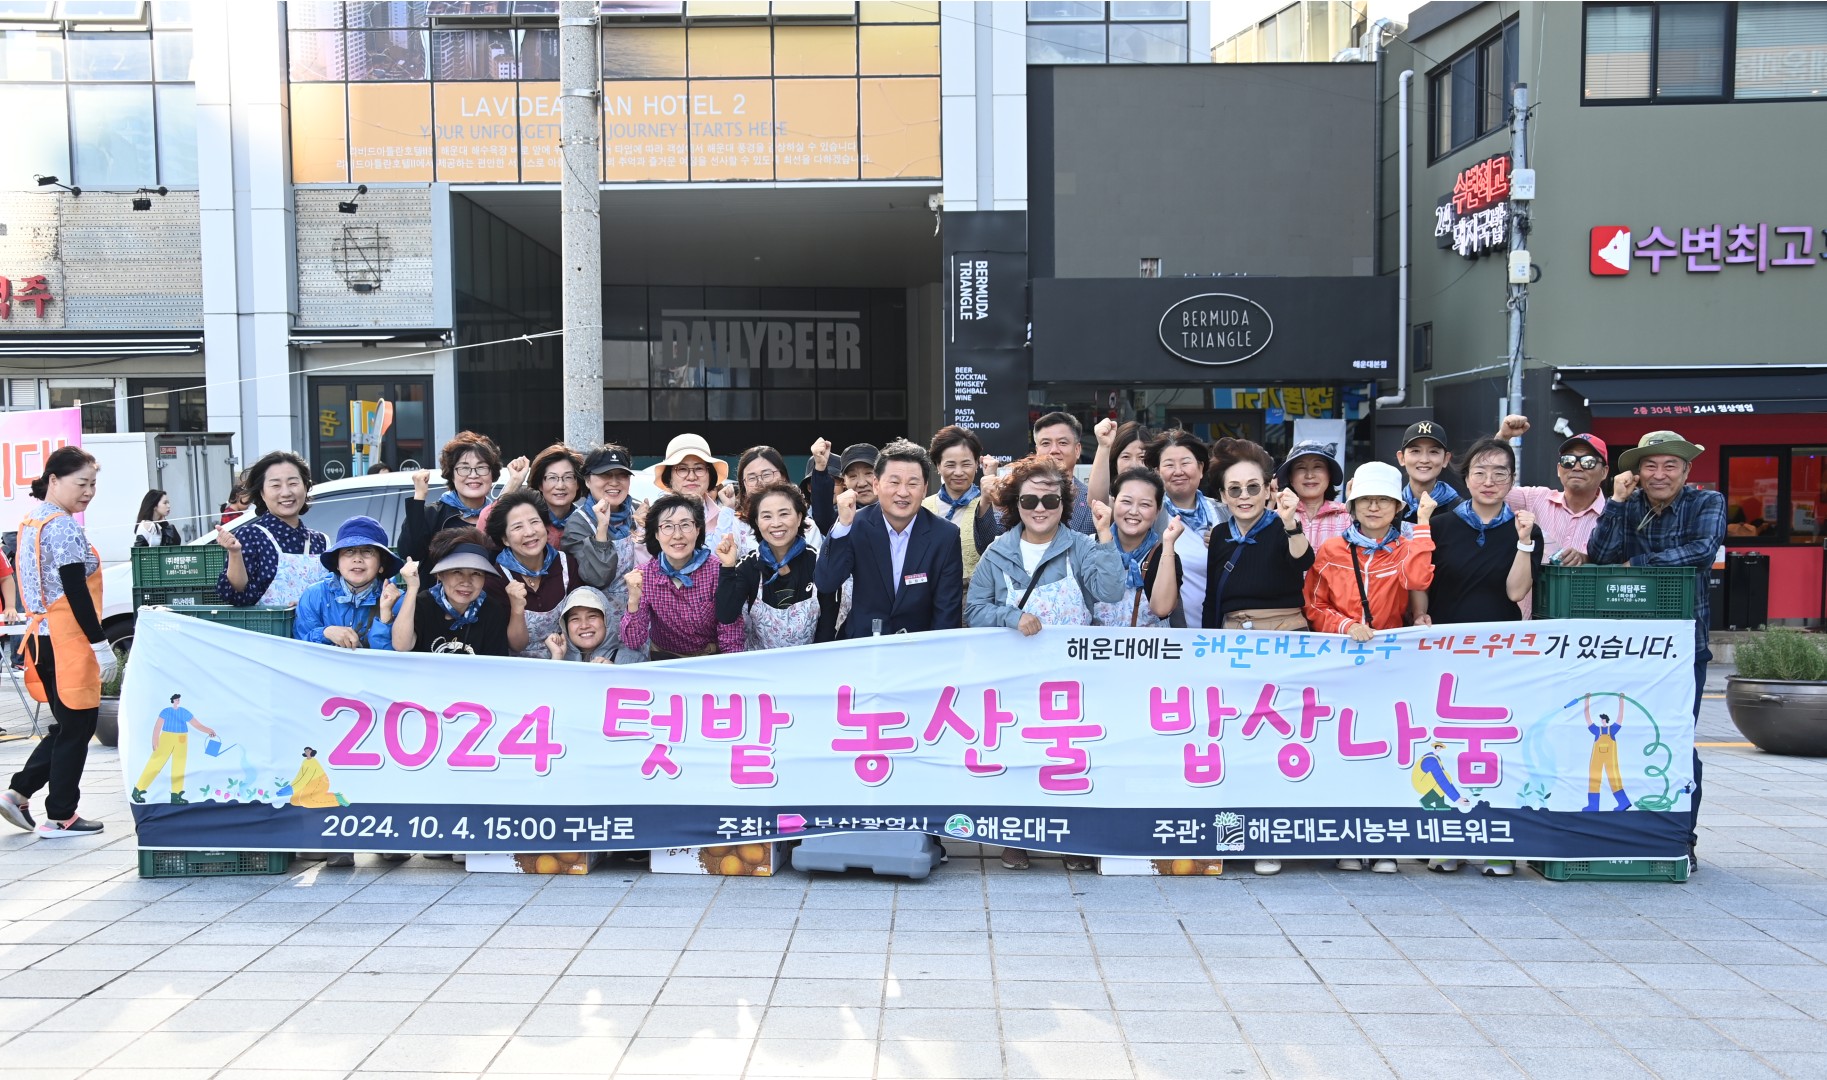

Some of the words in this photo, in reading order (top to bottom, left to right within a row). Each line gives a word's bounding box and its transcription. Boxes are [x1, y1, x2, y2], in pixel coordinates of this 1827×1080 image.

[643, 94, 722, 116] HOTEL
[733, 94, 746, 115] 2
[420, 123, 465, 140] YOUR
[470, 123, 561, 140] UNFORGETT
[608, 122, 678, 140] JOURNEY
[441, 145, 468, 156] 해운대
[707, 143, 734, 153] 해운대
[808, 142, 817, 152] 수
[741, 156, 749, 166] 수
[1452, 156, 1507, 214] 수변최고
[1634, 223, 1817, 274] 수변최고
[960, 260, 973, 320] TRIANGLE
[975, 260, 989, 320] BERMUDA
[1182, 309, 1250, 327] BERMUDA
[661, 320, 861, 370] DAILYBEER
[1181, 330, 1252, 348] TRIANGLE
[1693, 404, 1716, 414] 24시
[1418, 422, 1432, 434] NY
[1067, 637, 1183, 660] 해운대에는
[1419, 634, 1570, 659] 네트워크가
[1577, 635, 1677, 659] 있습니다.
[320, 696, 565, 776] 2024
[602, 686, 792, 787] 텃밭
[831, 680, 1105, 793] 농산물
[1149, 672, 1520, 786] 밥상나눔
[321, 815, 399, 838] 2024.
[408, 816, 444, 839] 10.
[451, 816, 475, 839] 4.
[483, 817, 556, 840] 15:00
[563, 817, 635, 842] 구남로
[716, 816, 771, 838] 주최:
[977, 816, 1071, 843] 해운대구
[1152, 819, 1206, 844] 주관:
[1248, 818, 1410, 844] 해운대도시농부
[1416, 818, 1515, 844] 네트워크
